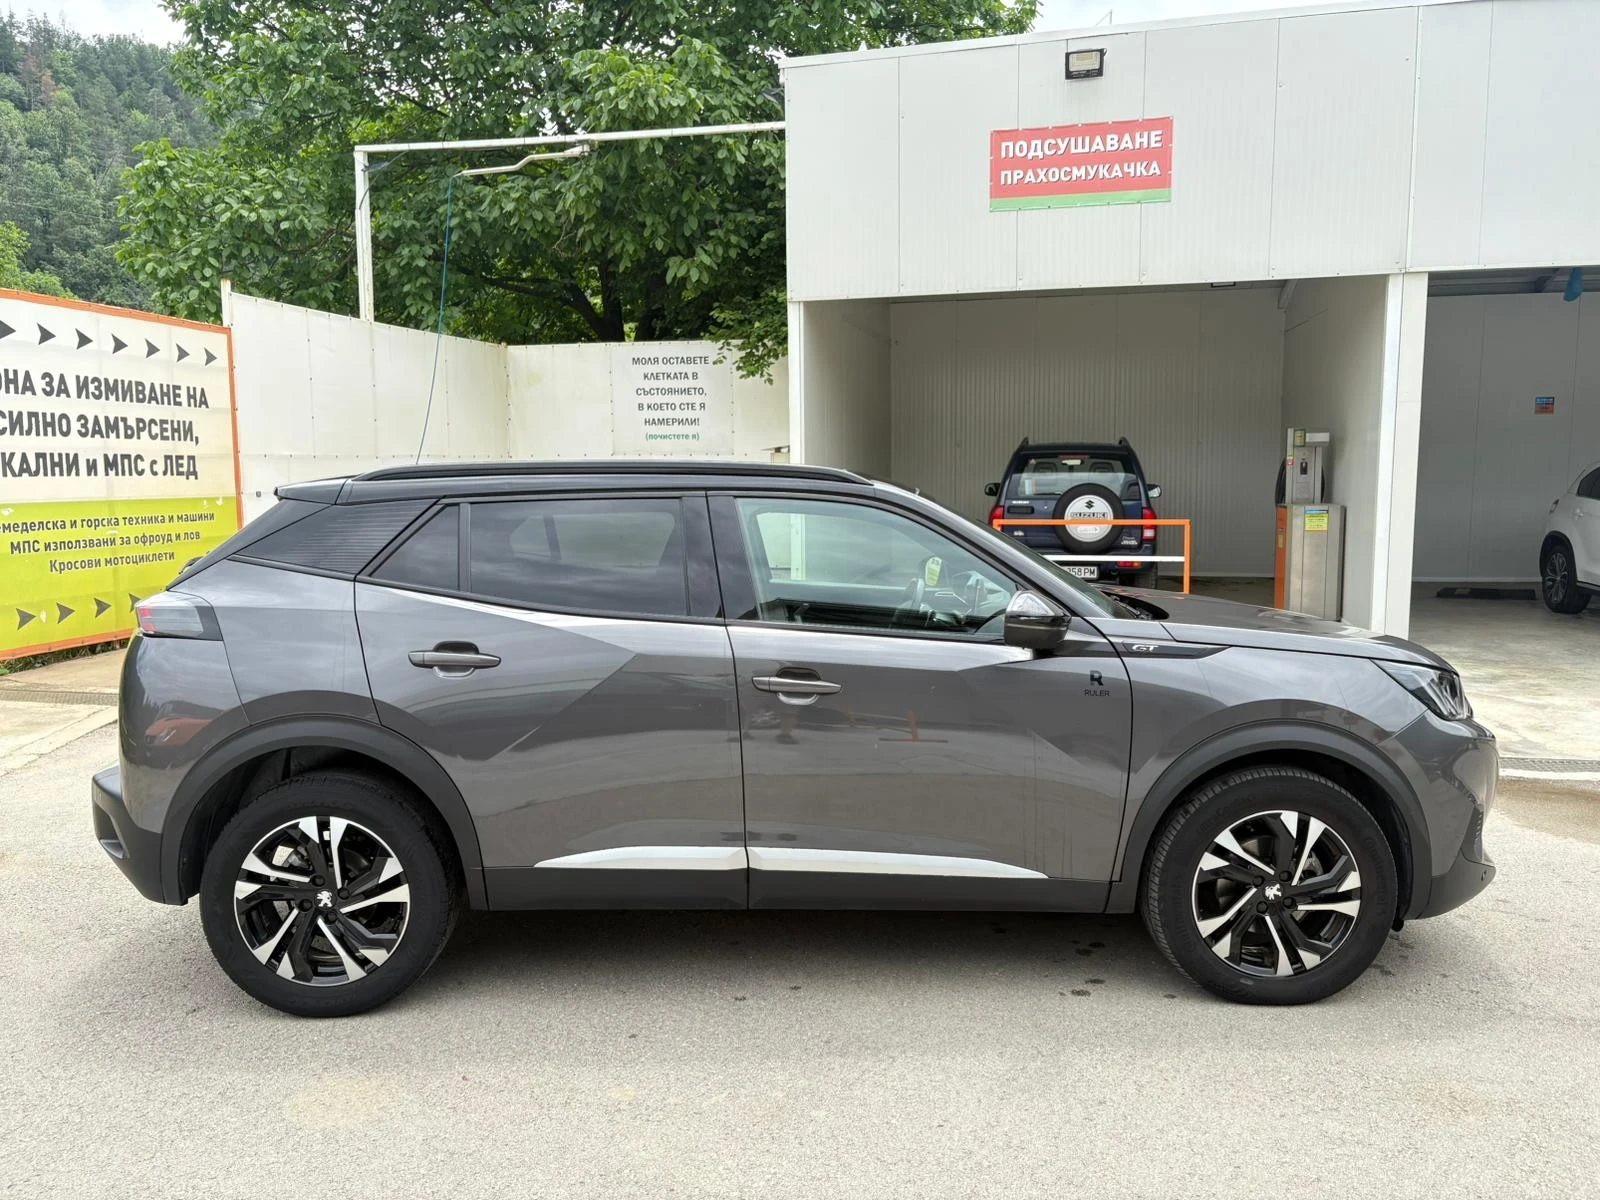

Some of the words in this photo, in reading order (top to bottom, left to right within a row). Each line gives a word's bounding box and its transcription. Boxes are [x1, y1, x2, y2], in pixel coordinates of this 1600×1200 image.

[1000, 129, 1163, 160] ПОДСУШАВАНЕ
[1000, 160, 1161, 185] ПРАХОСМУКАЧКА
[632, 356, 659, 365] МОЛЯ
[662, 356, 710, 365] ОСТАВЕТЕ
[643, 372, 689, 381] КЛЕТКАТА
[692, 372, 698, 380] В
[0, 368, 37, 396] НА
[41, 371, 71, 399] ЗА
[75, 374, 183, 407] ИЗМИВАНЕ
[187, 386, 210, 409] НА
[636, 387, 707, 397] СЪСТОЯНИЕТО,
[638, 403, 644, 411] В
[647, 402, 677, 411] КОЕТО
[679, 402, 696, 411] СТЕ
[699, 402, 706, 411] Я
[644, 417, 700, 427] НАМЕРИЛИ!
[76, 414, 200, 446] ЗАМЪРСЕНИ,
[645, 432, 690, 441] (почистете
[691, 432, 700, 441] я)
[1, 451, 81, 478] КАЛНИ
[86, 458, 98, 477] и
[103, 453, 146, 477] МПС
[150, 458, 158, 476] с
[162, 455, 199, 480] ЛЕД
[1070, 511, 1108, 519] SUZUKI
[0, 517, 66, 534] меделска
[70, 518, 78, 529] и
[80, 515, 120, 531] горска
[122, 513, 166, 527] техника
[168, 514, 174, 524] и
[177, 511, 215, 523] машини
[10, 540, 41, 555] МПС
[44, 536, 116, 552] използвани
[119, 534, 132, 546] за
[134, 531, 173, 549] офроуд
[175, 532, 182, 542] и
[183, 530, 201, 541] лов
[49, 555, 102, 575] Кросови
[104, 551, 175, 569] мотоциклети
[1131, 644, 1159, 653] GT
[1089, 670, 1104, 687] R
[1084, 689, 1110, 697] RULER
